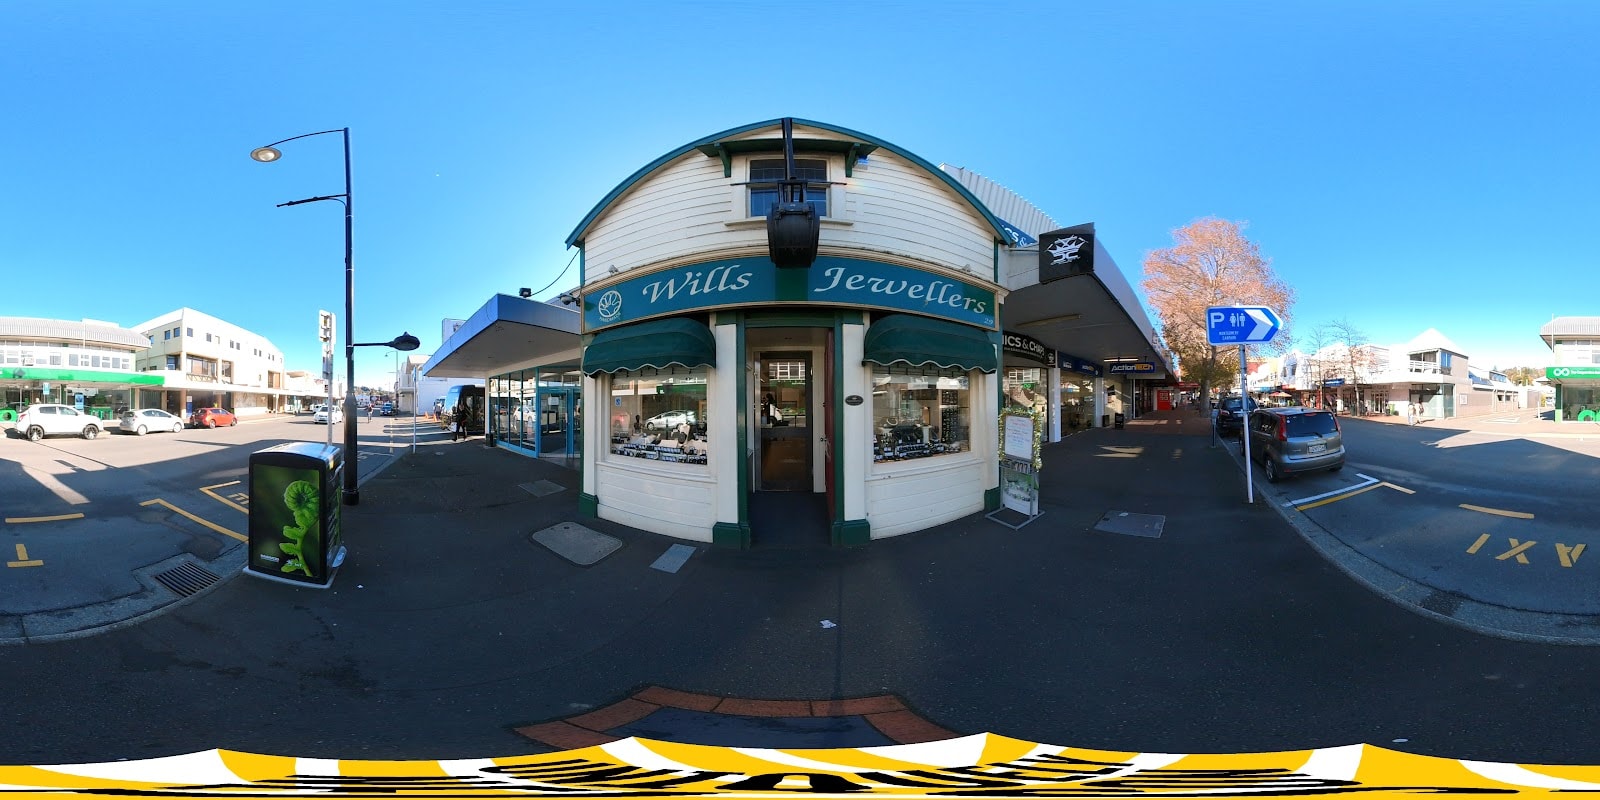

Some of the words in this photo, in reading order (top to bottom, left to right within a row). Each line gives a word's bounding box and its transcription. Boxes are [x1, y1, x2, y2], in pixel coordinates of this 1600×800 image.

[643, 265, 752, 303] Wills
[814, 267, 987, 314] Jewellers
[1210, 312, 1225, 328] P
